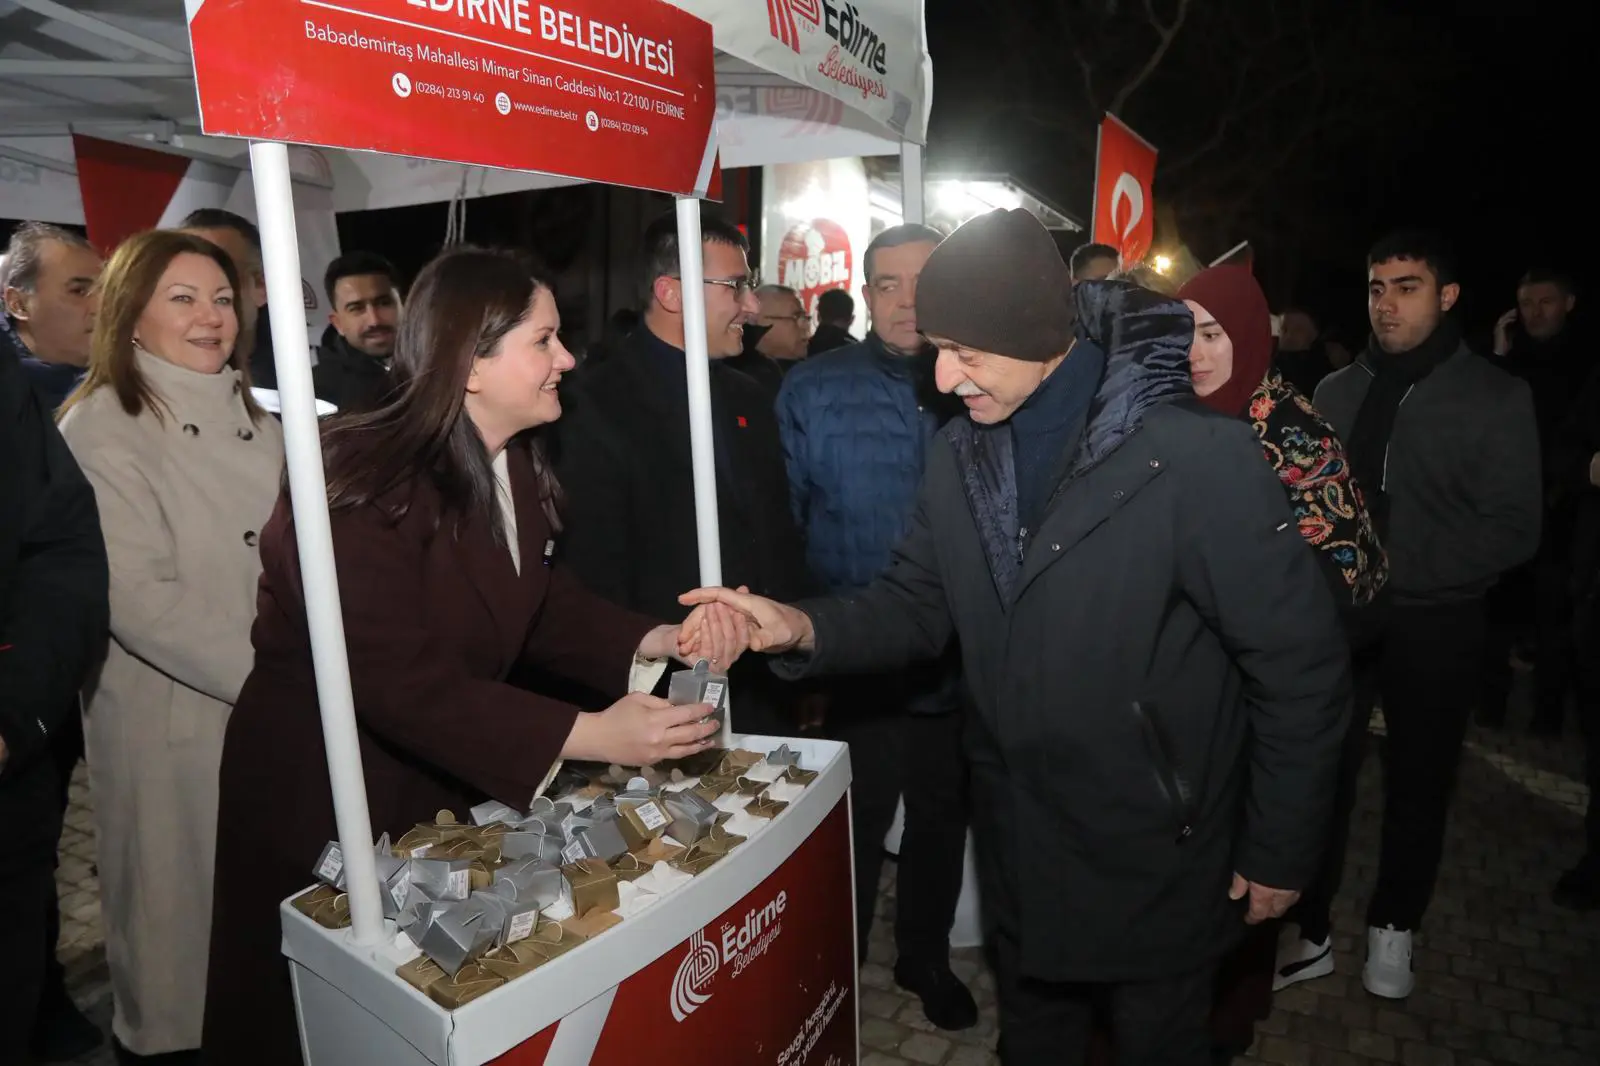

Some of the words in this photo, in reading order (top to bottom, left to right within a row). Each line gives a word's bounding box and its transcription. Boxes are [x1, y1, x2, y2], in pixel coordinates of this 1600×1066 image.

[305, 20, 413, 62] Babademirtaş
[417, 43, 479, 72] Mahallesi
[482, 58, 520, 80] Mimar
[522, 68, 552, 88] Sinan
[555, 76, 596, 98] Caddesi
[598, 85, 620, 103] No:1
[622, 91, 650, 111] 22100
[656, 101, 685, 120] EDİRNE
[540, 5, 674, 77] BELEDİYESİ
[821, 0, 887, 75] Edirne
[415, 81, 445, 98] (0284)
[446, 87, 461, 99] 213
[462, 90, 471, 101] 91
[473, 92, 485, 104] 40
[818, 45, 887, 100] Belediyesi
[600, 117, 621, 132] (0284)
[621, 122, 633, 133] 212
[632, 125, 641, 134] 09
[640, 127, 649, 136] 94
[721, 889, 788, 966] Edirne
[731, 918, 782, 979] Belediyesi
